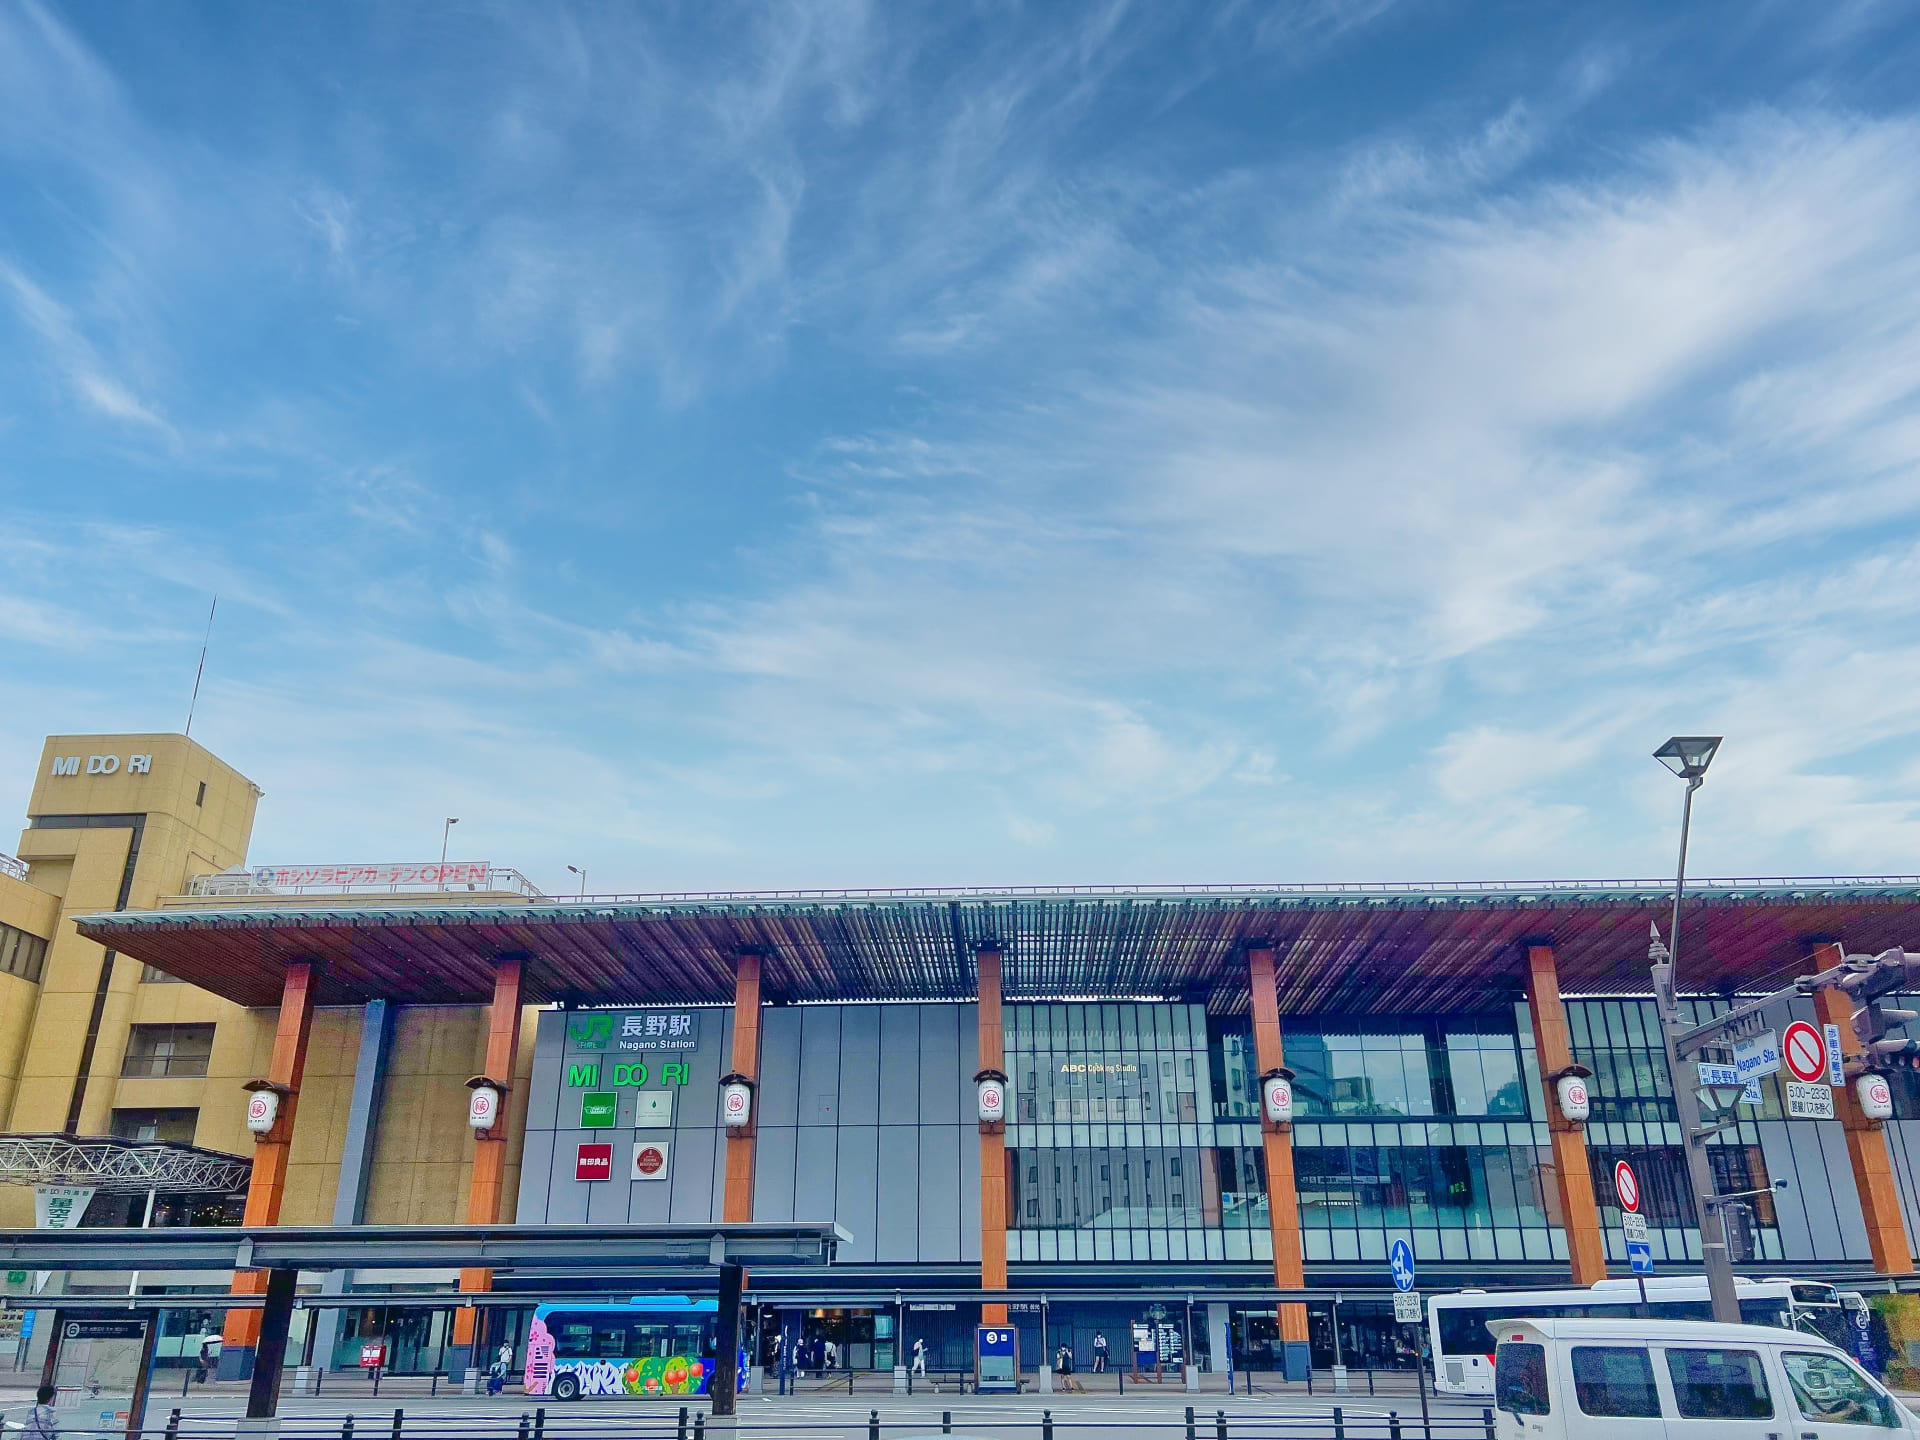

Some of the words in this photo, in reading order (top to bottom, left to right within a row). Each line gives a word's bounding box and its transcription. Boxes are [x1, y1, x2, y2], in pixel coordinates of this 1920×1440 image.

[51, 756, 80, 776] MI
[86, 754, 120, 775] DO
[127, 754, 152, 775] RI
[621, 1015, 691, 1037] 長野駅
[619, 1040, 657, 1051] Nagano
[659, 1039, 695, 1049] Station
[1061, 1064, 1086, 1073] ABC
[1736, 1055, 1761, 1072] Nagano
[1763, 1048, 1777, 1064] Sta.
[568, 1064, 599, 1087] MI
[613, 1063, 649, 1087] DO
[661, 1063, 690, 1086] RI
